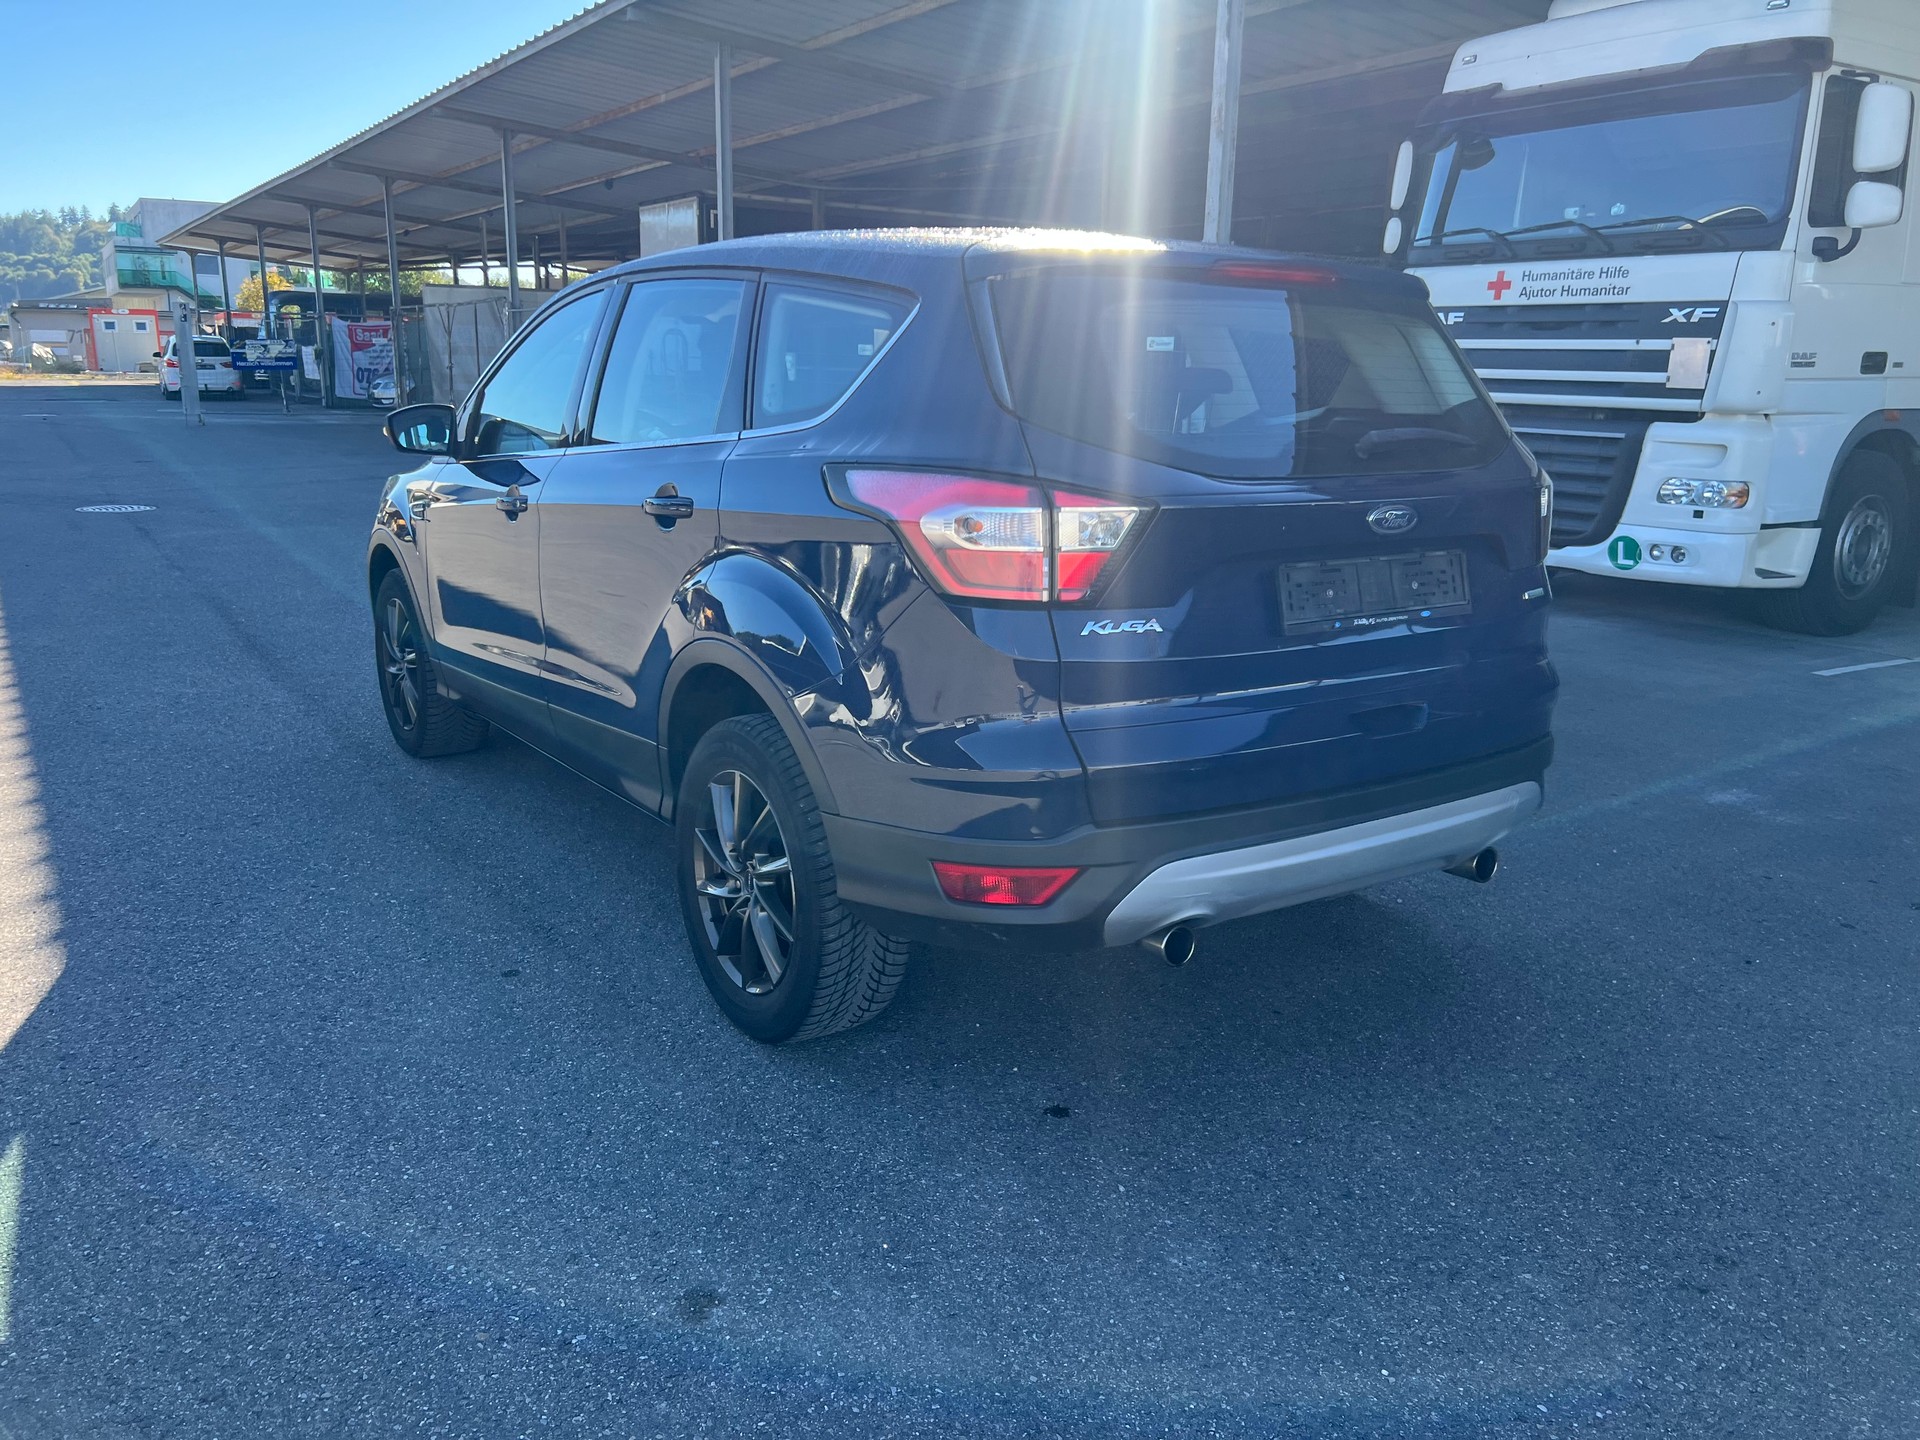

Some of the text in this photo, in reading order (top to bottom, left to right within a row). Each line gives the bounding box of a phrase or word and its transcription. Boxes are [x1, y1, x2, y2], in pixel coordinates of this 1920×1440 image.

[1521, 265, 1630, 282] Humanitäre Hilfe
[1518, 283, 1631, 300] Ajutor Humanitar
[1437, 312, 1465, 325] AF
[1660, 307, 1721, 323] XF
[1791, 352, 1817, 360] DAF
[1381, 510, 1410, 527] Ford
[1617, 541, 1635, 566] L
[1080, 618, 1164, 636] KUGA
